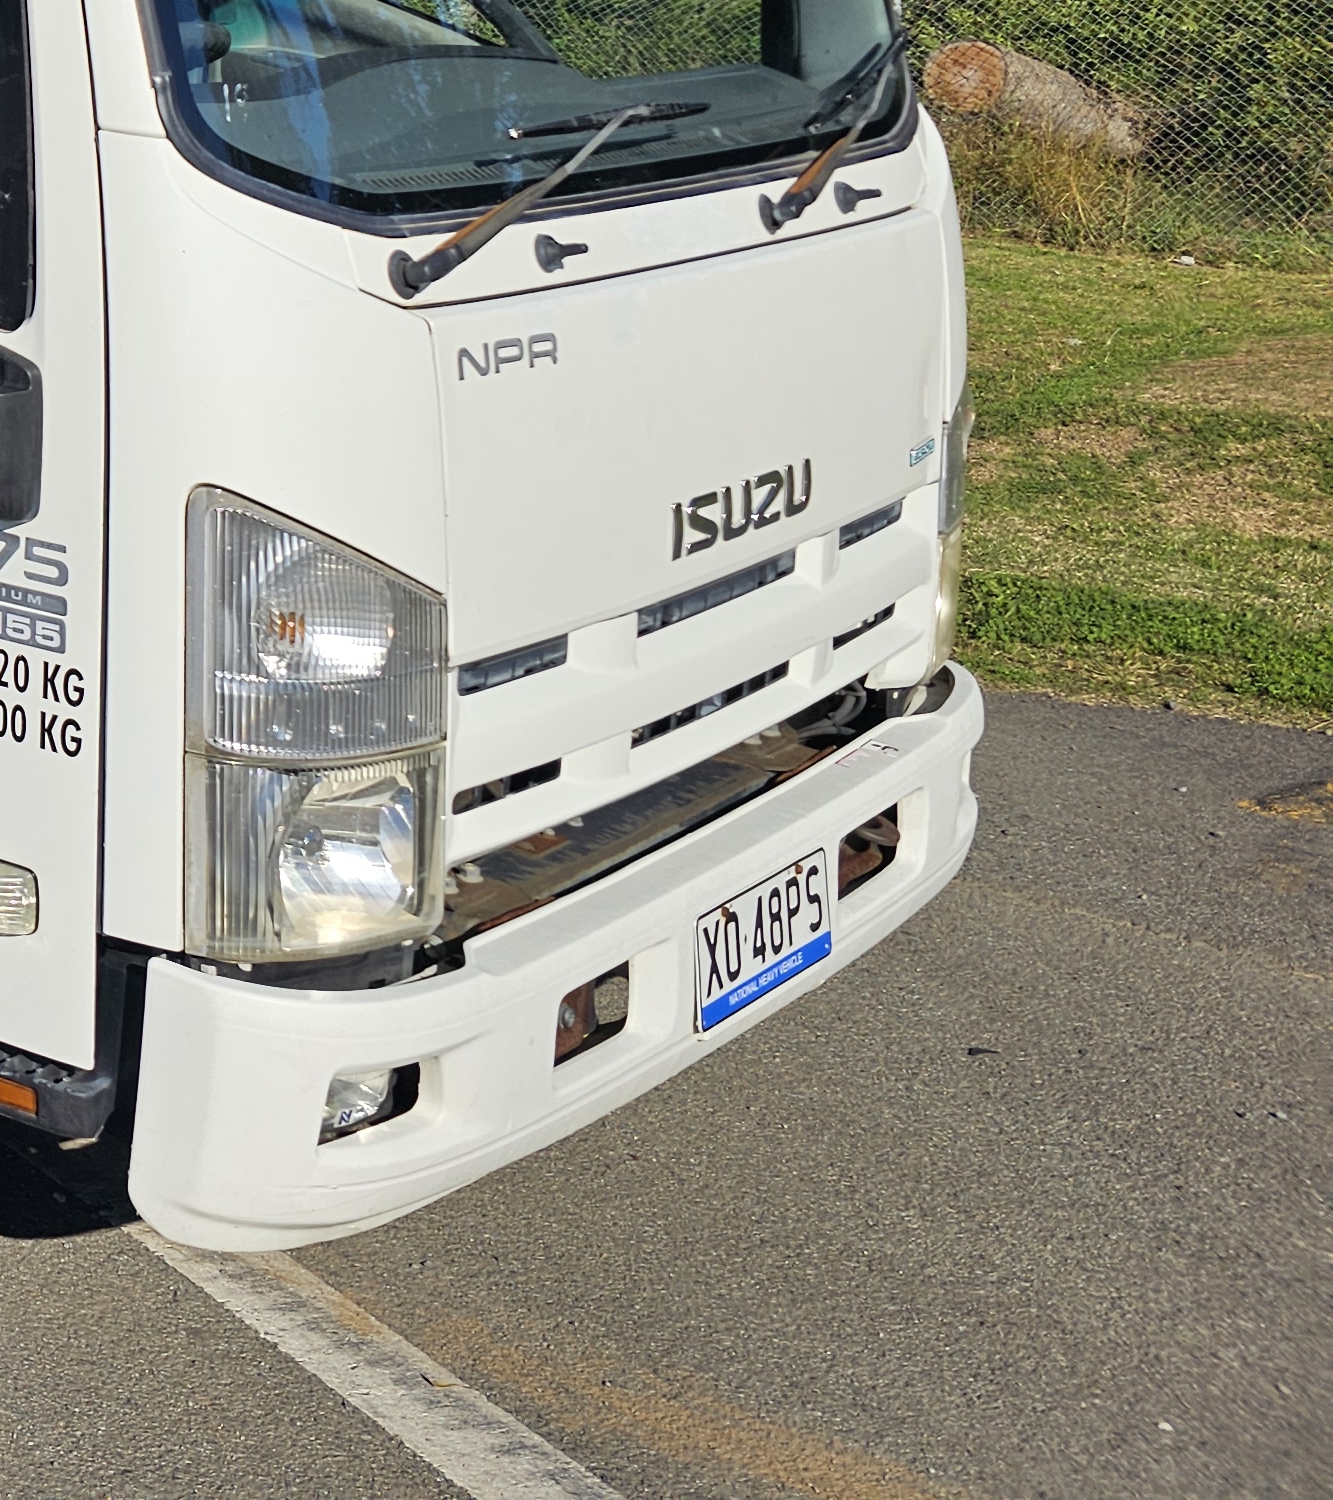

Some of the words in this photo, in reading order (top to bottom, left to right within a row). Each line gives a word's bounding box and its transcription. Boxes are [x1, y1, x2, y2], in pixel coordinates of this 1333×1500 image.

[457, 332, 558, 381] NPR
[669, 457, 812, 562] ISUZU
[42, 660, 85, 707] KG
[39, 710, 82, 758] KG
[728, 979, 759, 1007] NATIONAL
[757, 967, 781, 987] HEAVY
[778, 951, 804, 975] VEHICLE
